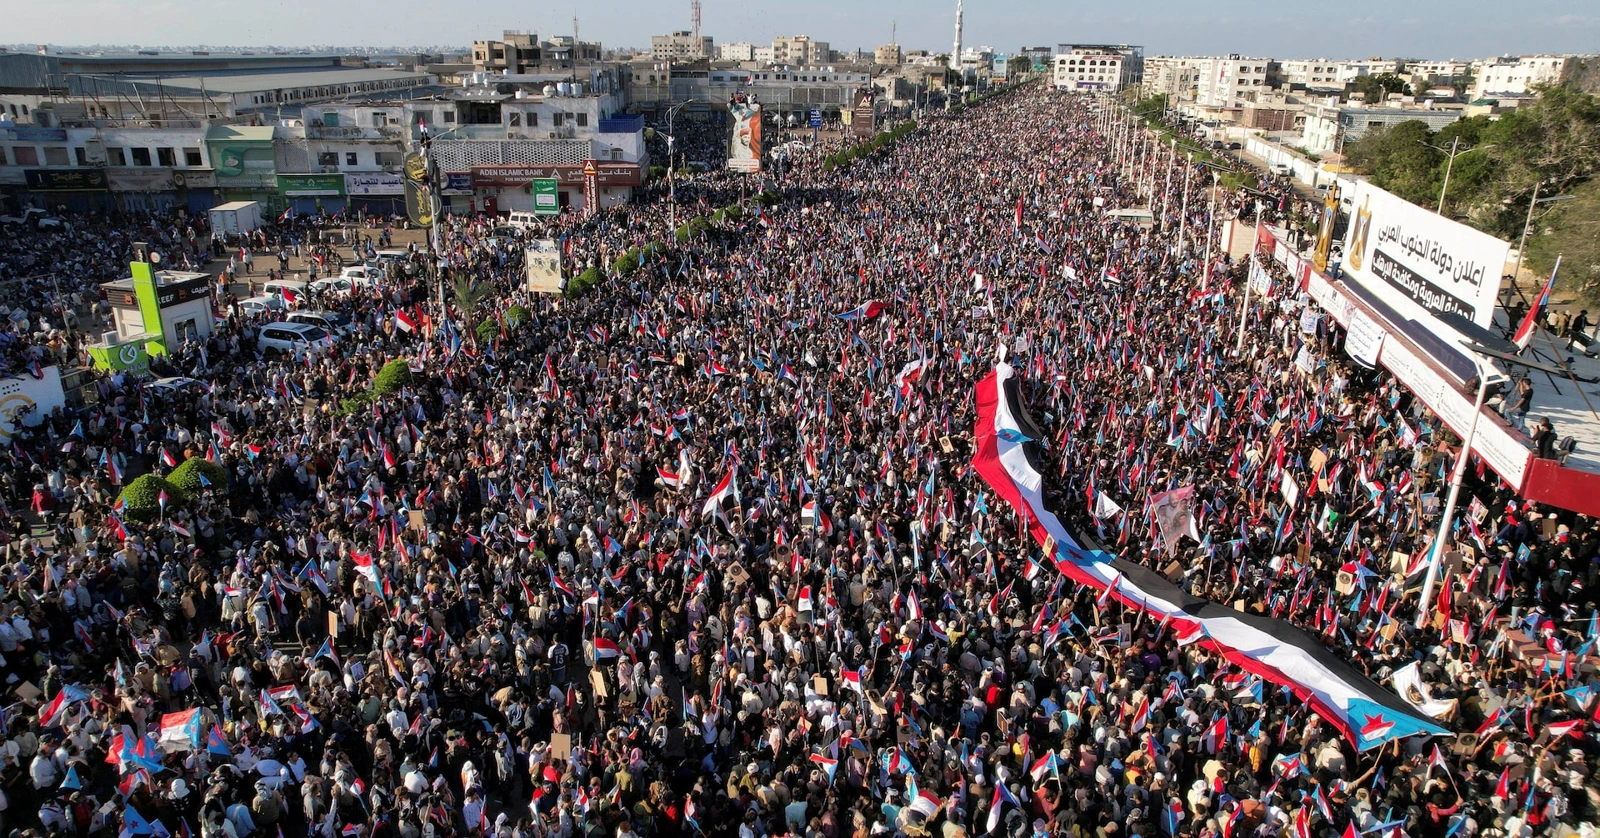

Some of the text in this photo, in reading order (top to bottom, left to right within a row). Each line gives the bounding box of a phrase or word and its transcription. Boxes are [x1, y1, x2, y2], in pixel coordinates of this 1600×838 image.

[353, 178, 404, 187] اعبيد للتجارة
[613, 168, 632, 177] بنك
[1372, 254, 1393, 280] الإرهاب
[1378, 224, 1486, 297] إعلان دولة الجنوب العربي
[1391, 263, 1420, 299] ومكافحة
[1419, 280, 1446, 312] العروبة
[555, 654, 564, 664] 13
